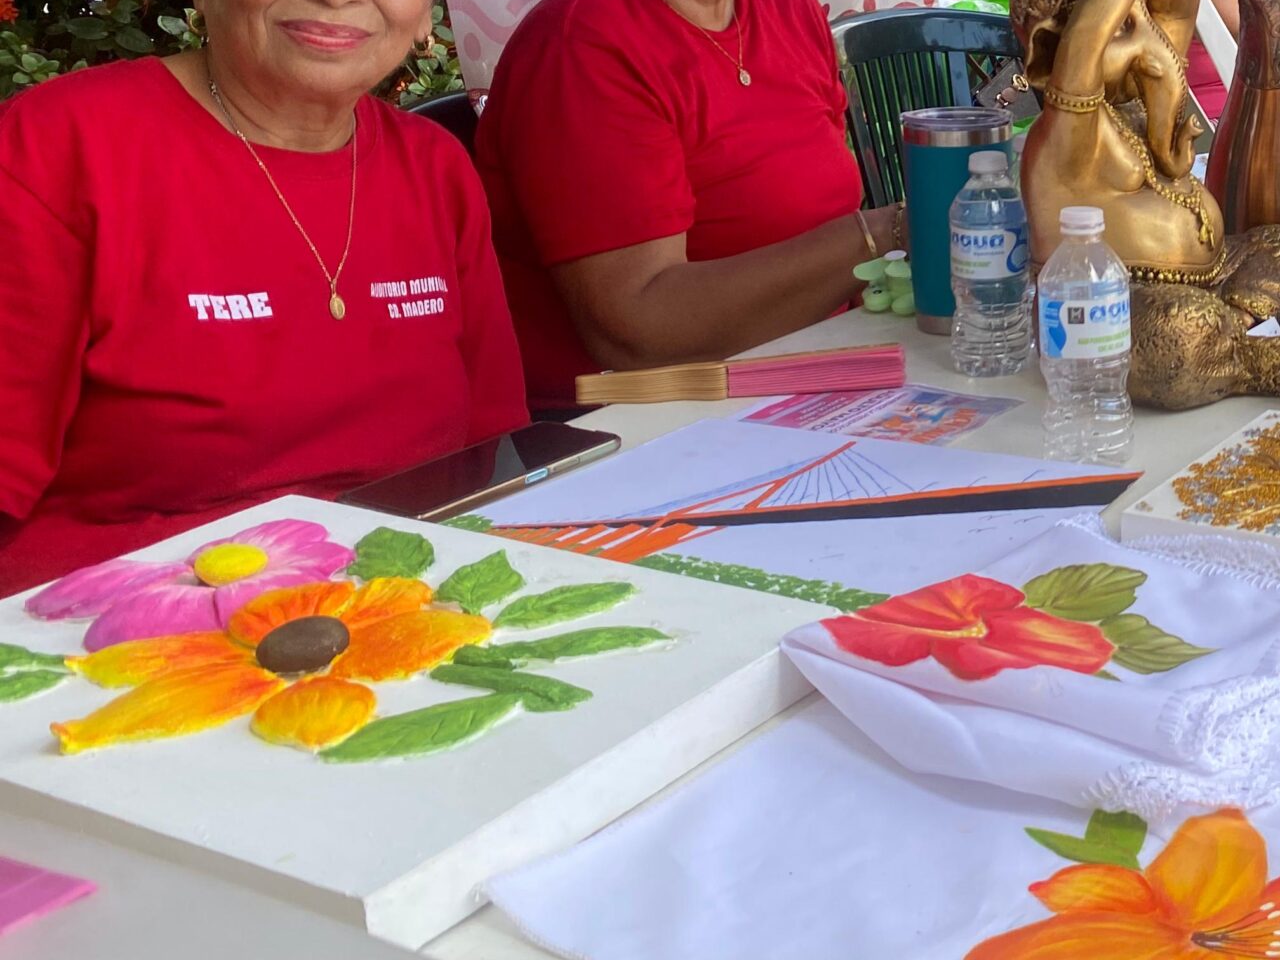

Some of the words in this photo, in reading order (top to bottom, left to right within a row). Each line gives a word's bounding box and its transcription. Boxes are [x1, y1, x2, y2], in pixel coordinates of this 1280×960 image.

[370, 280, 408, 298] AUDITORIO
[188, 292, 273, 320] TERE
[401, 297, 444, 318] MADERO
